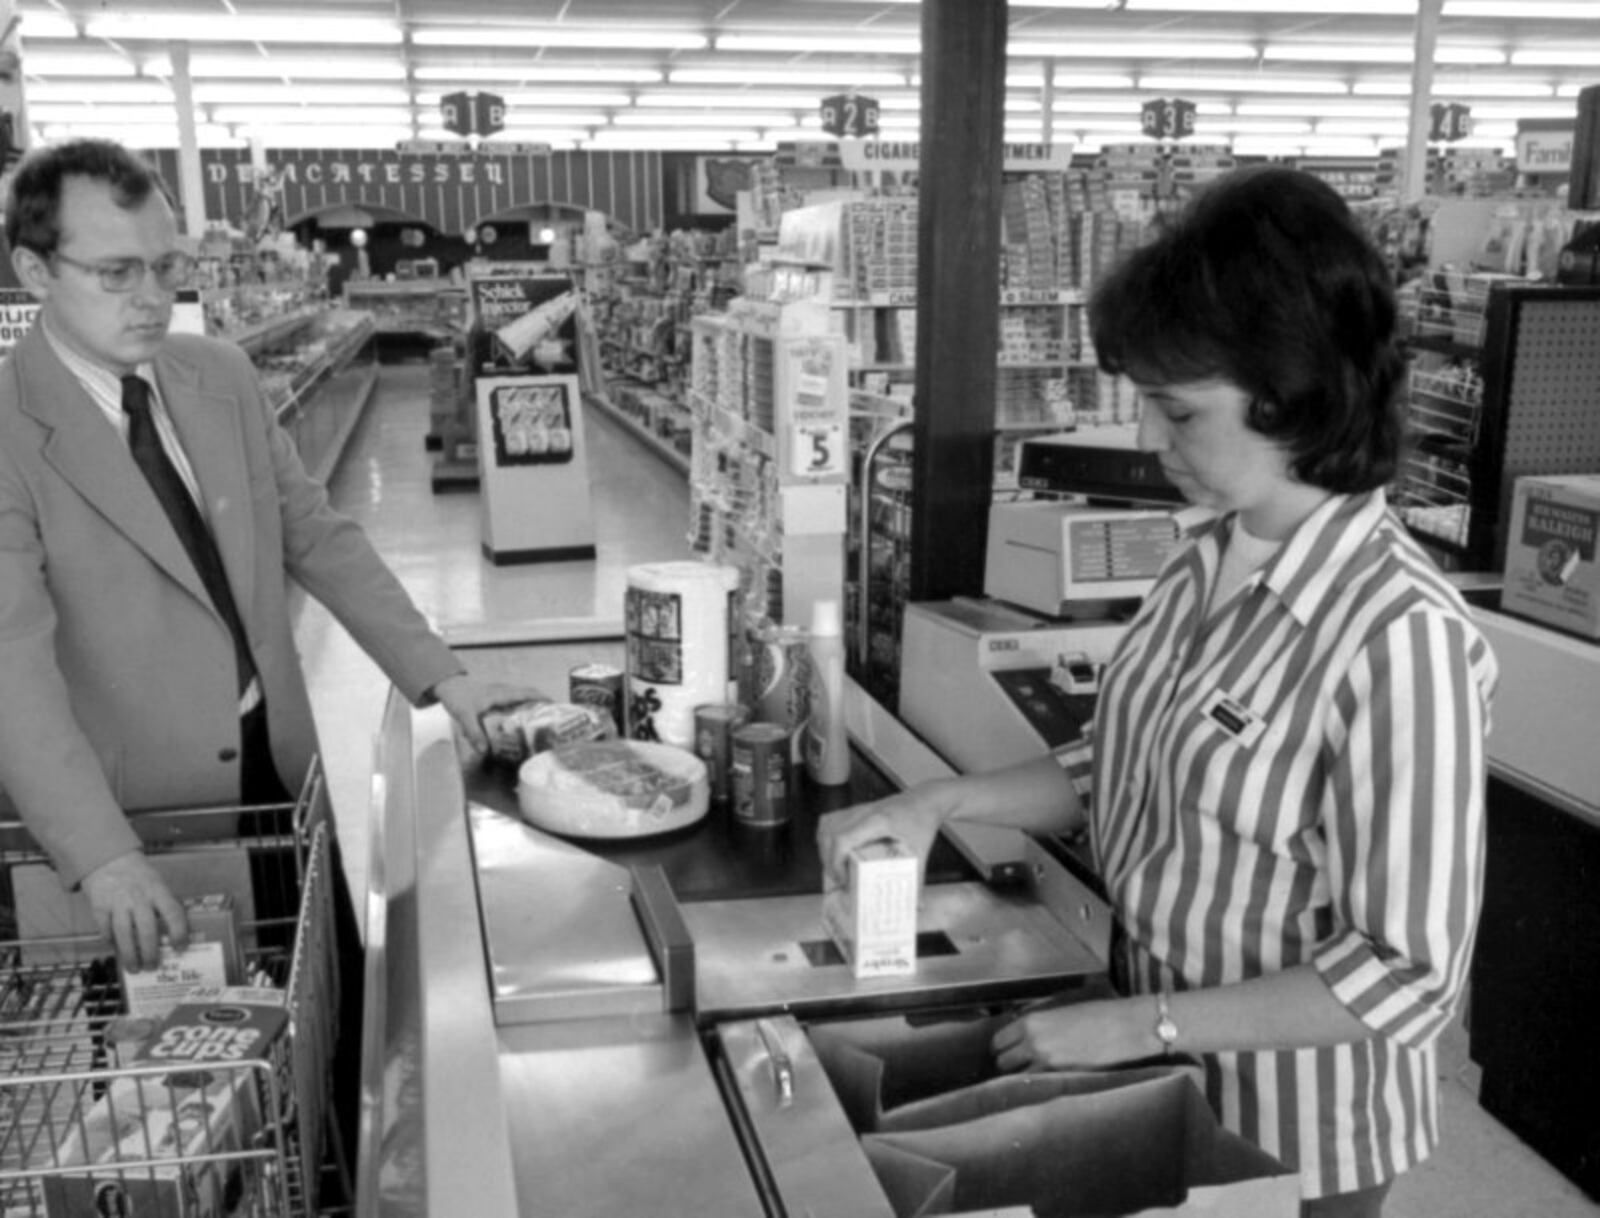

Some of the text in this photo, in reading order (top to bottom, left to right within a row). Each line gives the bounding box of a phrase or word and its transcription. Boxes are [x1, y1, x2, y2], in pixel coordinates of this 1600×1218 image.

[443, 105, 457, 125] A
[490, 105, 504, 126] B
[822, 102, 878, 133] A 2 B
[1164, 106, 1176, 134] 3
[1440, 109, 1452, 138] 4
[863, 143, 1052, 160] CIGARE TMENT
[1525, 140, 1571, 164] Famil
[206, 162, 503, 185] DEICATESSEN
[812, 434, 830, 466] 5
[1527, 514, 1594, 543] RALEIGH
[160, 1025, 261, 1043] cone
[150, 1039, 249, 1061] cups
